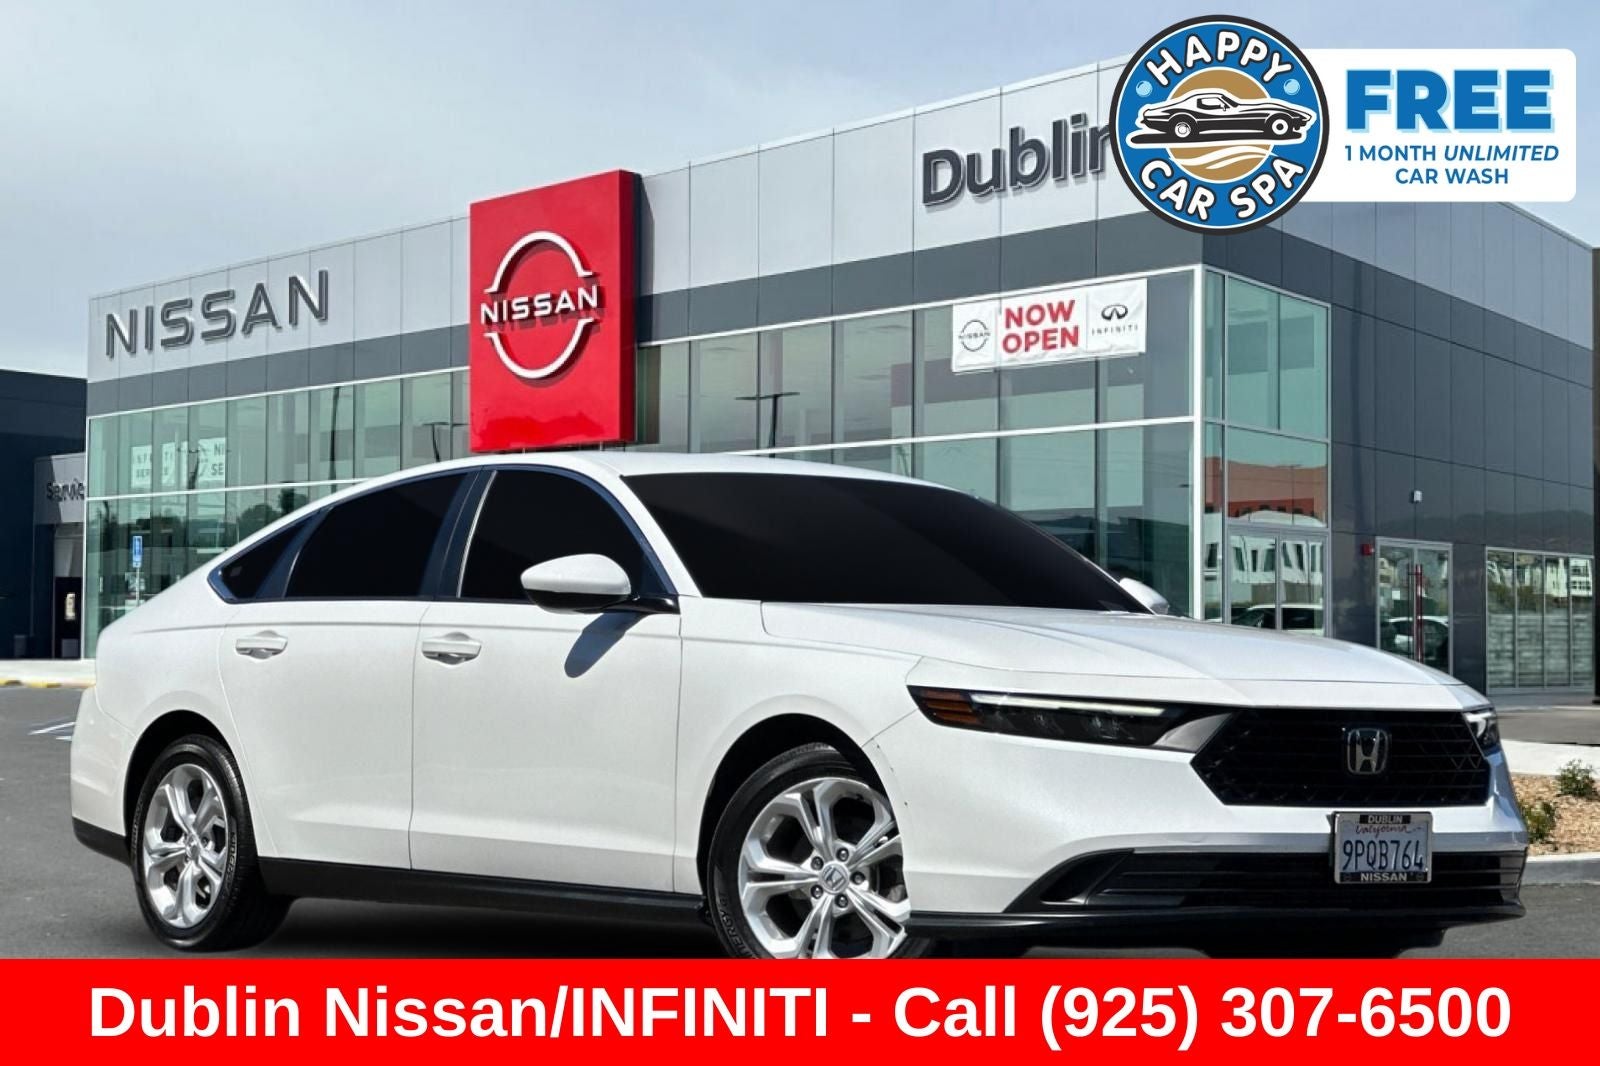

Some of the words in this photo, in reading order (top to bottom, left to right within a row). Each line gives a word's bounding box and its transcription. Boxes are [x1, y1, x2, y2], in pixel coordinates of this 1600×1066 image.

[105, 269, 329, 359] NISSAN
[480, 284, 599, 325] NISSAN
[1005, 299, 1076, 329] NOW
[1002, 325, 1079, 354] OPEN
[1091, 324, 1138, 336] INFINITI
[46, 477, 85, 502] Servic
[1367, 814, 1403, 824] DUBLIN
[1342, 839, 1424, 872] 9PQB764
[1360, 872, 1408, 882] NISSAN
